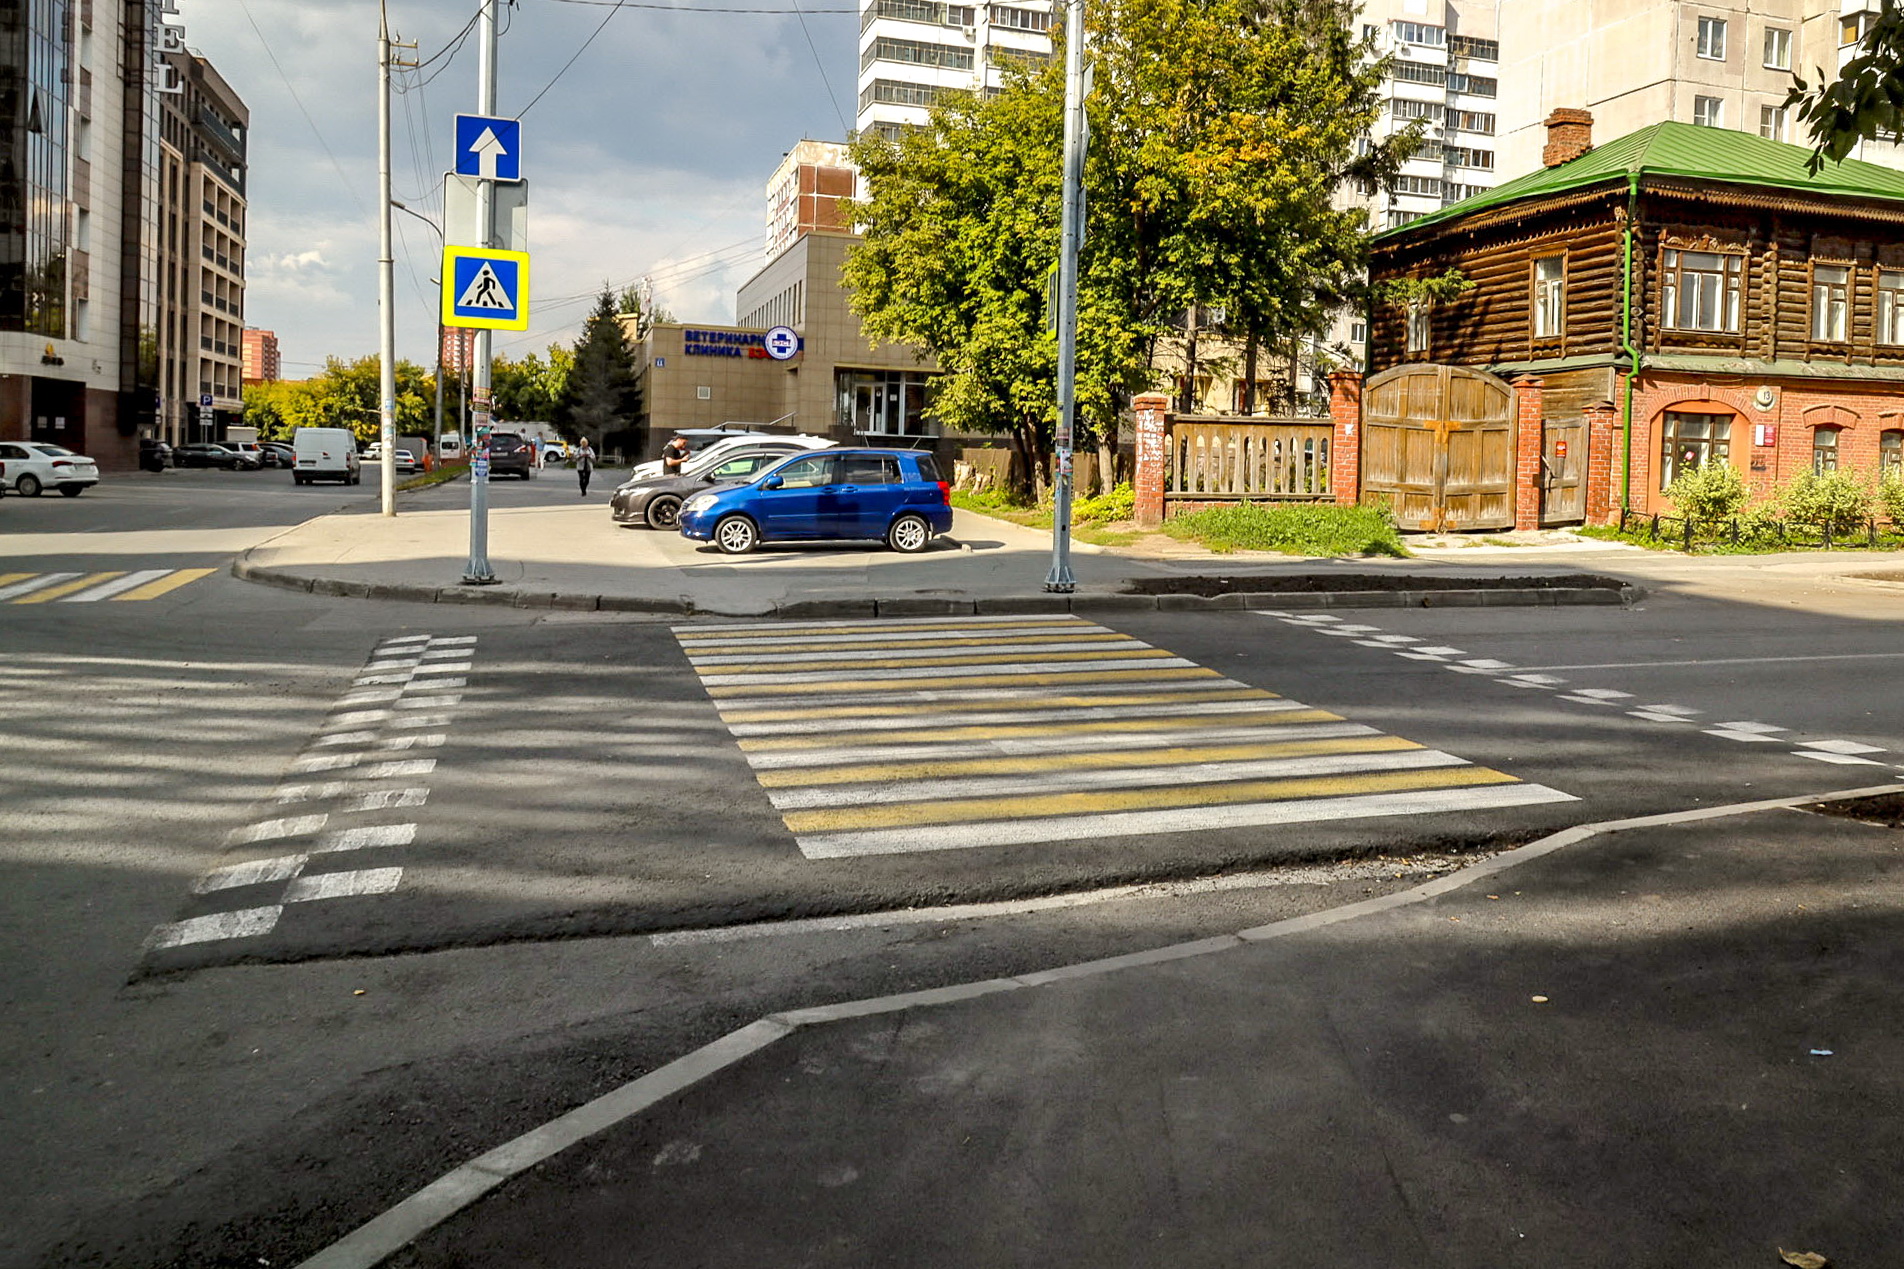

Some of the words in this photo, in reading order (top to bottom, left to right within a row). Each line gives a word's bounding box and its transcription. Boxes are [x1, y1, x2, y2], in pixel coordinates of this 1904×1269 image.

[685, 330, 766, 345] ВЕТЕРИНАРН
[685, 344, 742, 357] КЛИНИКА
[203, 396, 211, 405] P
[1763, 390, 1771, 400] 13
